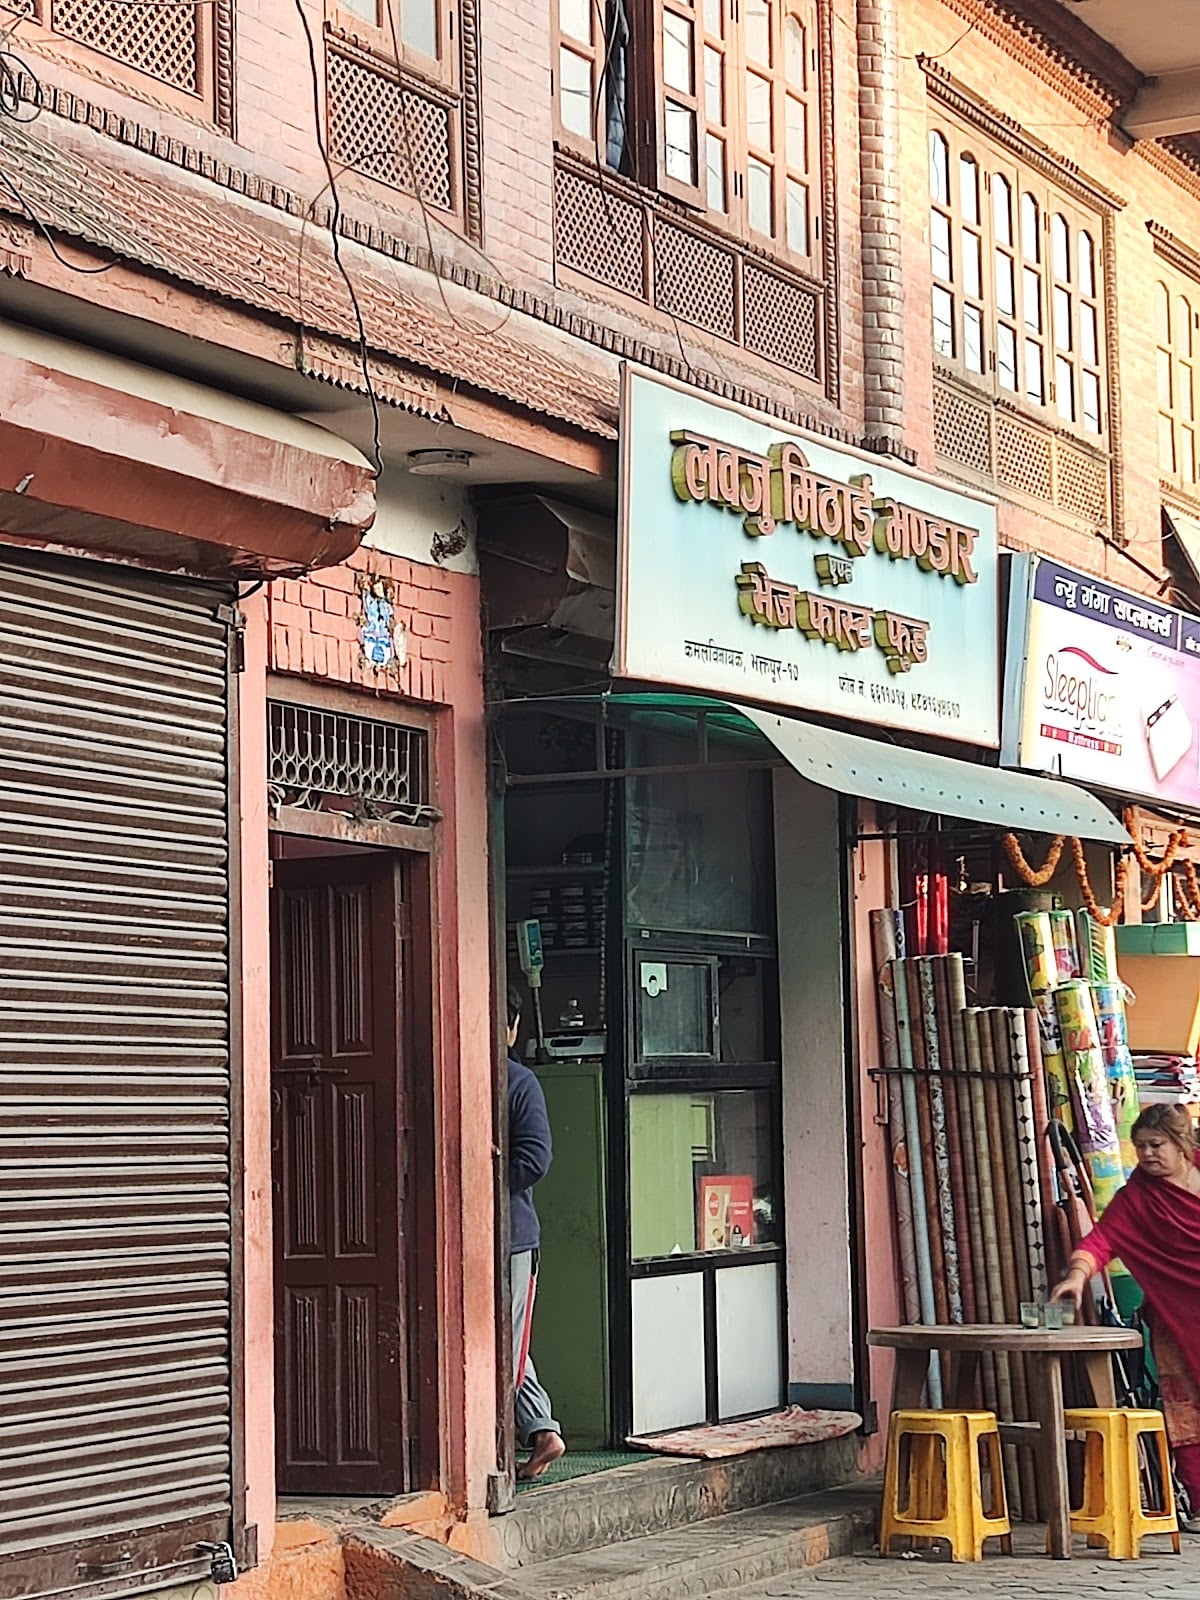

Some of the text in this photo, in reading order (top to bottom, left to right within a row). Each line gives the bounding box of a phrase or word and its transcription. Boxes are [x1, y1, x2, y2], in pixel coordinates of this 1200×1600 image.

[670, 429, 980, 584] लवजु मिठाई भण्डार
[796, 591, 875, 652] फास्ट
[1055, 575, 1079, 608] न्यू
[1081, 584, 1111, 614] गंगा
